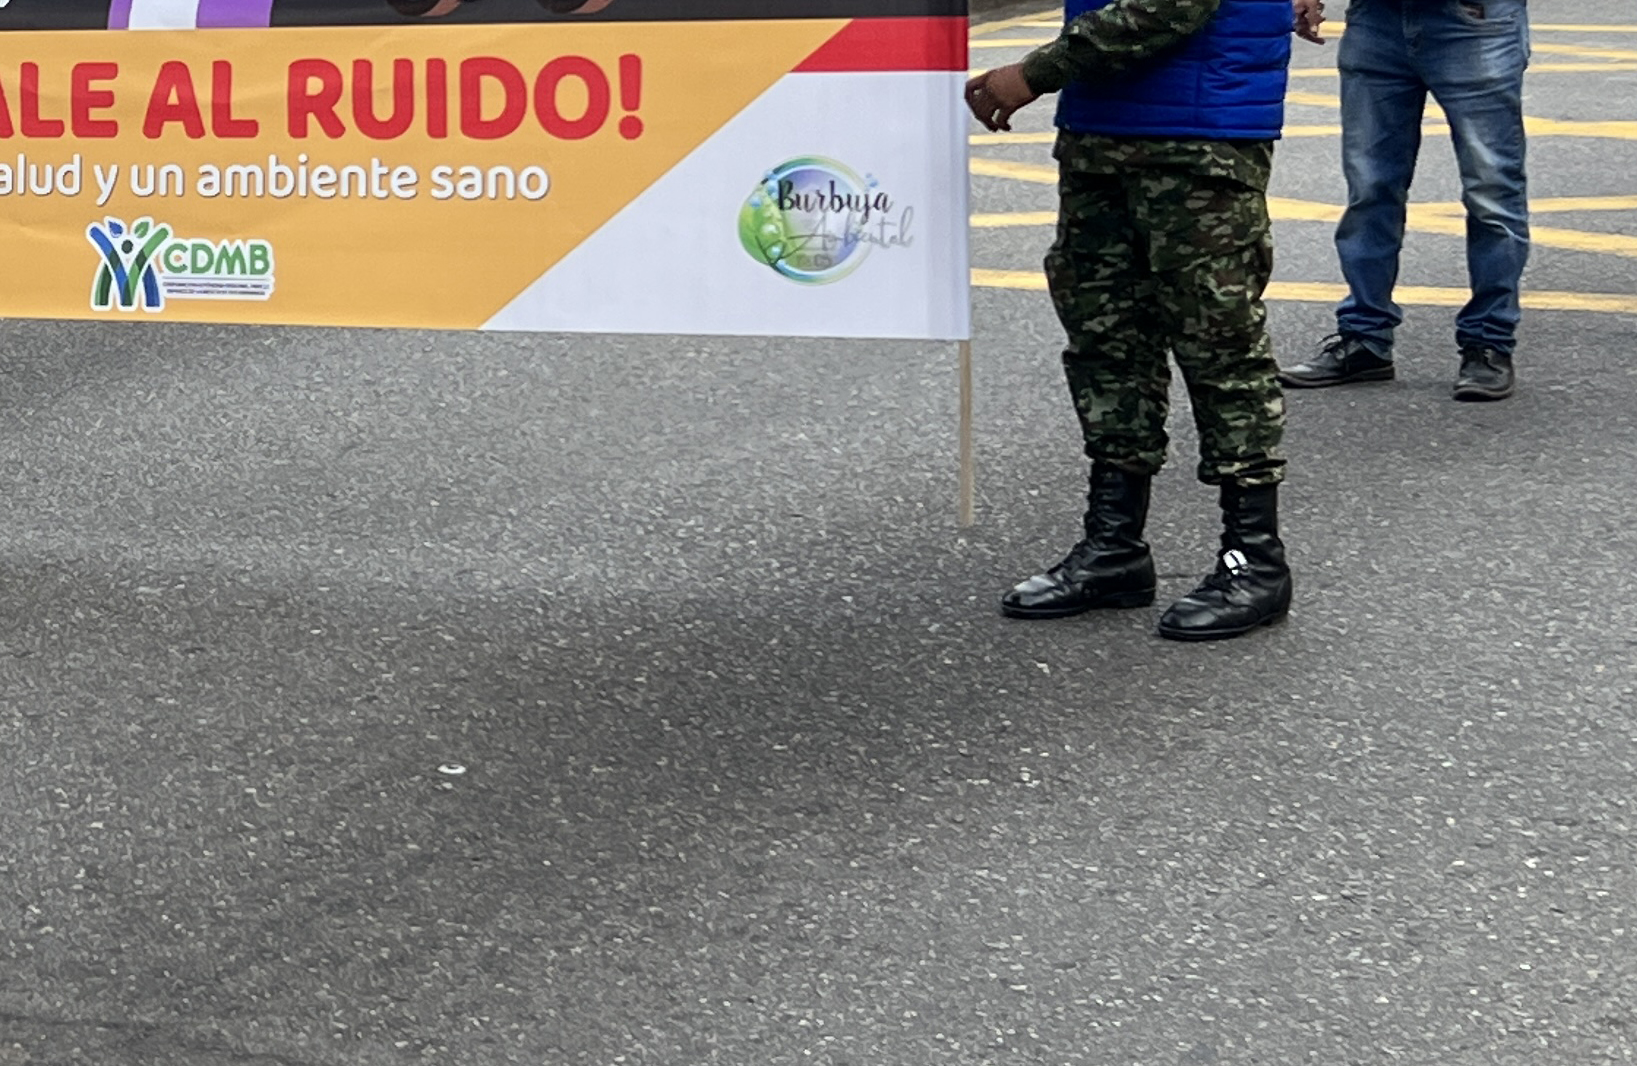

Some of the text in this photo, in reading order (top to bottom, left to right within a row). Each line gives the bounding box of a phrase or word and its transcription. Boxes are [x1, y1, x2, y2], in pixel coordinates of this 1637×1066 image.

[142, 60, 259, 140] AL
[287, 53, 644, 140] RUIDO!
[92, 162, 119, 207] y
[129, 162, 184, 198] un
[196, 153, 419, 200] ambiente
[430, 163, 551, 202] sano
[777, 179, 895, 225] Burbuja
[163, 243, 271, 276] CDMB
